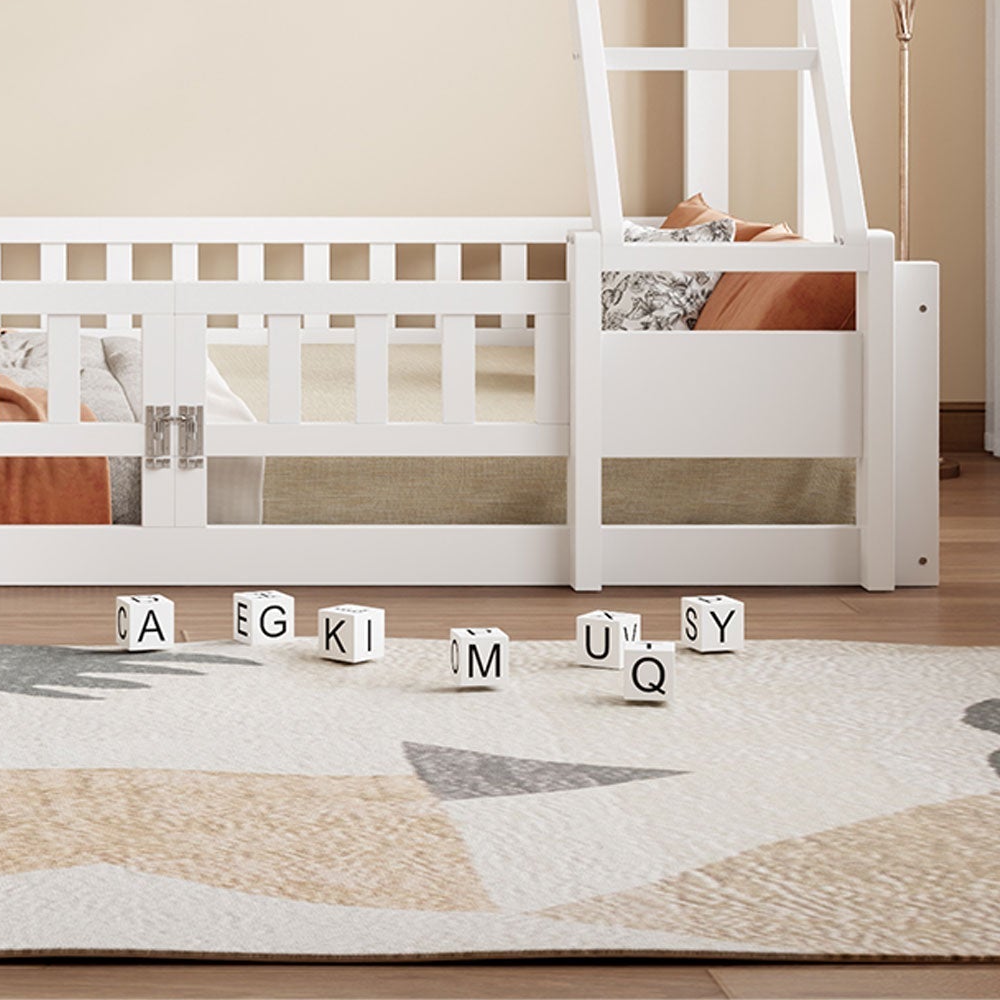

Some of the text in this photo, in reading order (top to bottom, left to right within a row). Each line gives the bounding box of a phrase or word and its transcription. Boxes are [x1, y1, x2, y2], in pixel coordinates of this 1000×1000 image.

[118, 606, 127, 640] C
[138, 610, 165, 642] A
[238, 602, 248, 637] E
[260, 605, 286, 637] G
[325, 618, 346, 653] K
[367, 620, 372, 651] I
[686, 607, 697, 641] S
[710, 610, 735, 643] Y
[586, 625, 609, 660] U
[469, 643, 500, 678] M
[632, 657, 665, 695] Q
